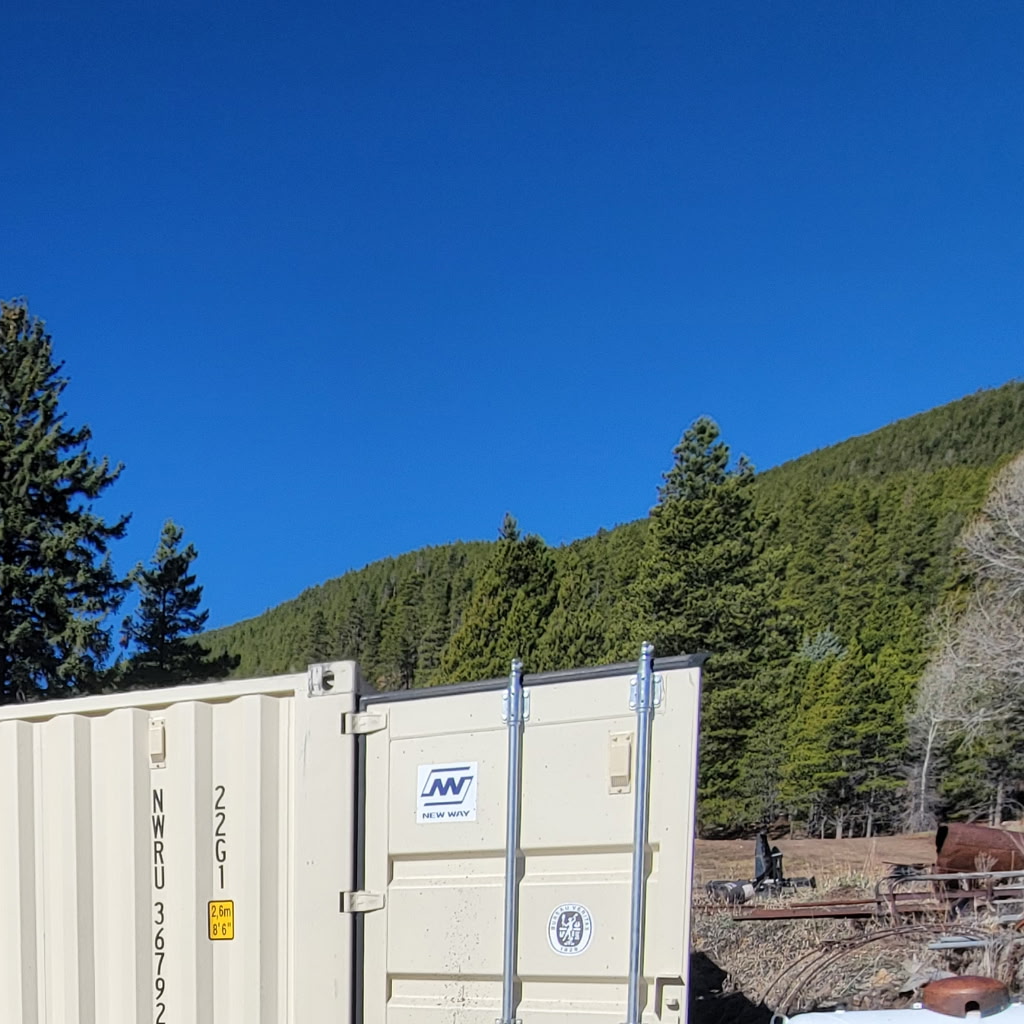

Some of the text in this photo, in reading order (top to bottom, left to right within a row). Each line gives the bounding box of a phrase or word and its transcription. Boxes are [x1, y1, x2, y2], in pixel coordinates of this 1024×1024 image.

[152, 788, 165, 889] NWRU
[215, 785, 226, 889] 22G1
[422, 810, 470, 819] NEW WAY
[211, 904, 231, 920] 2,6m
